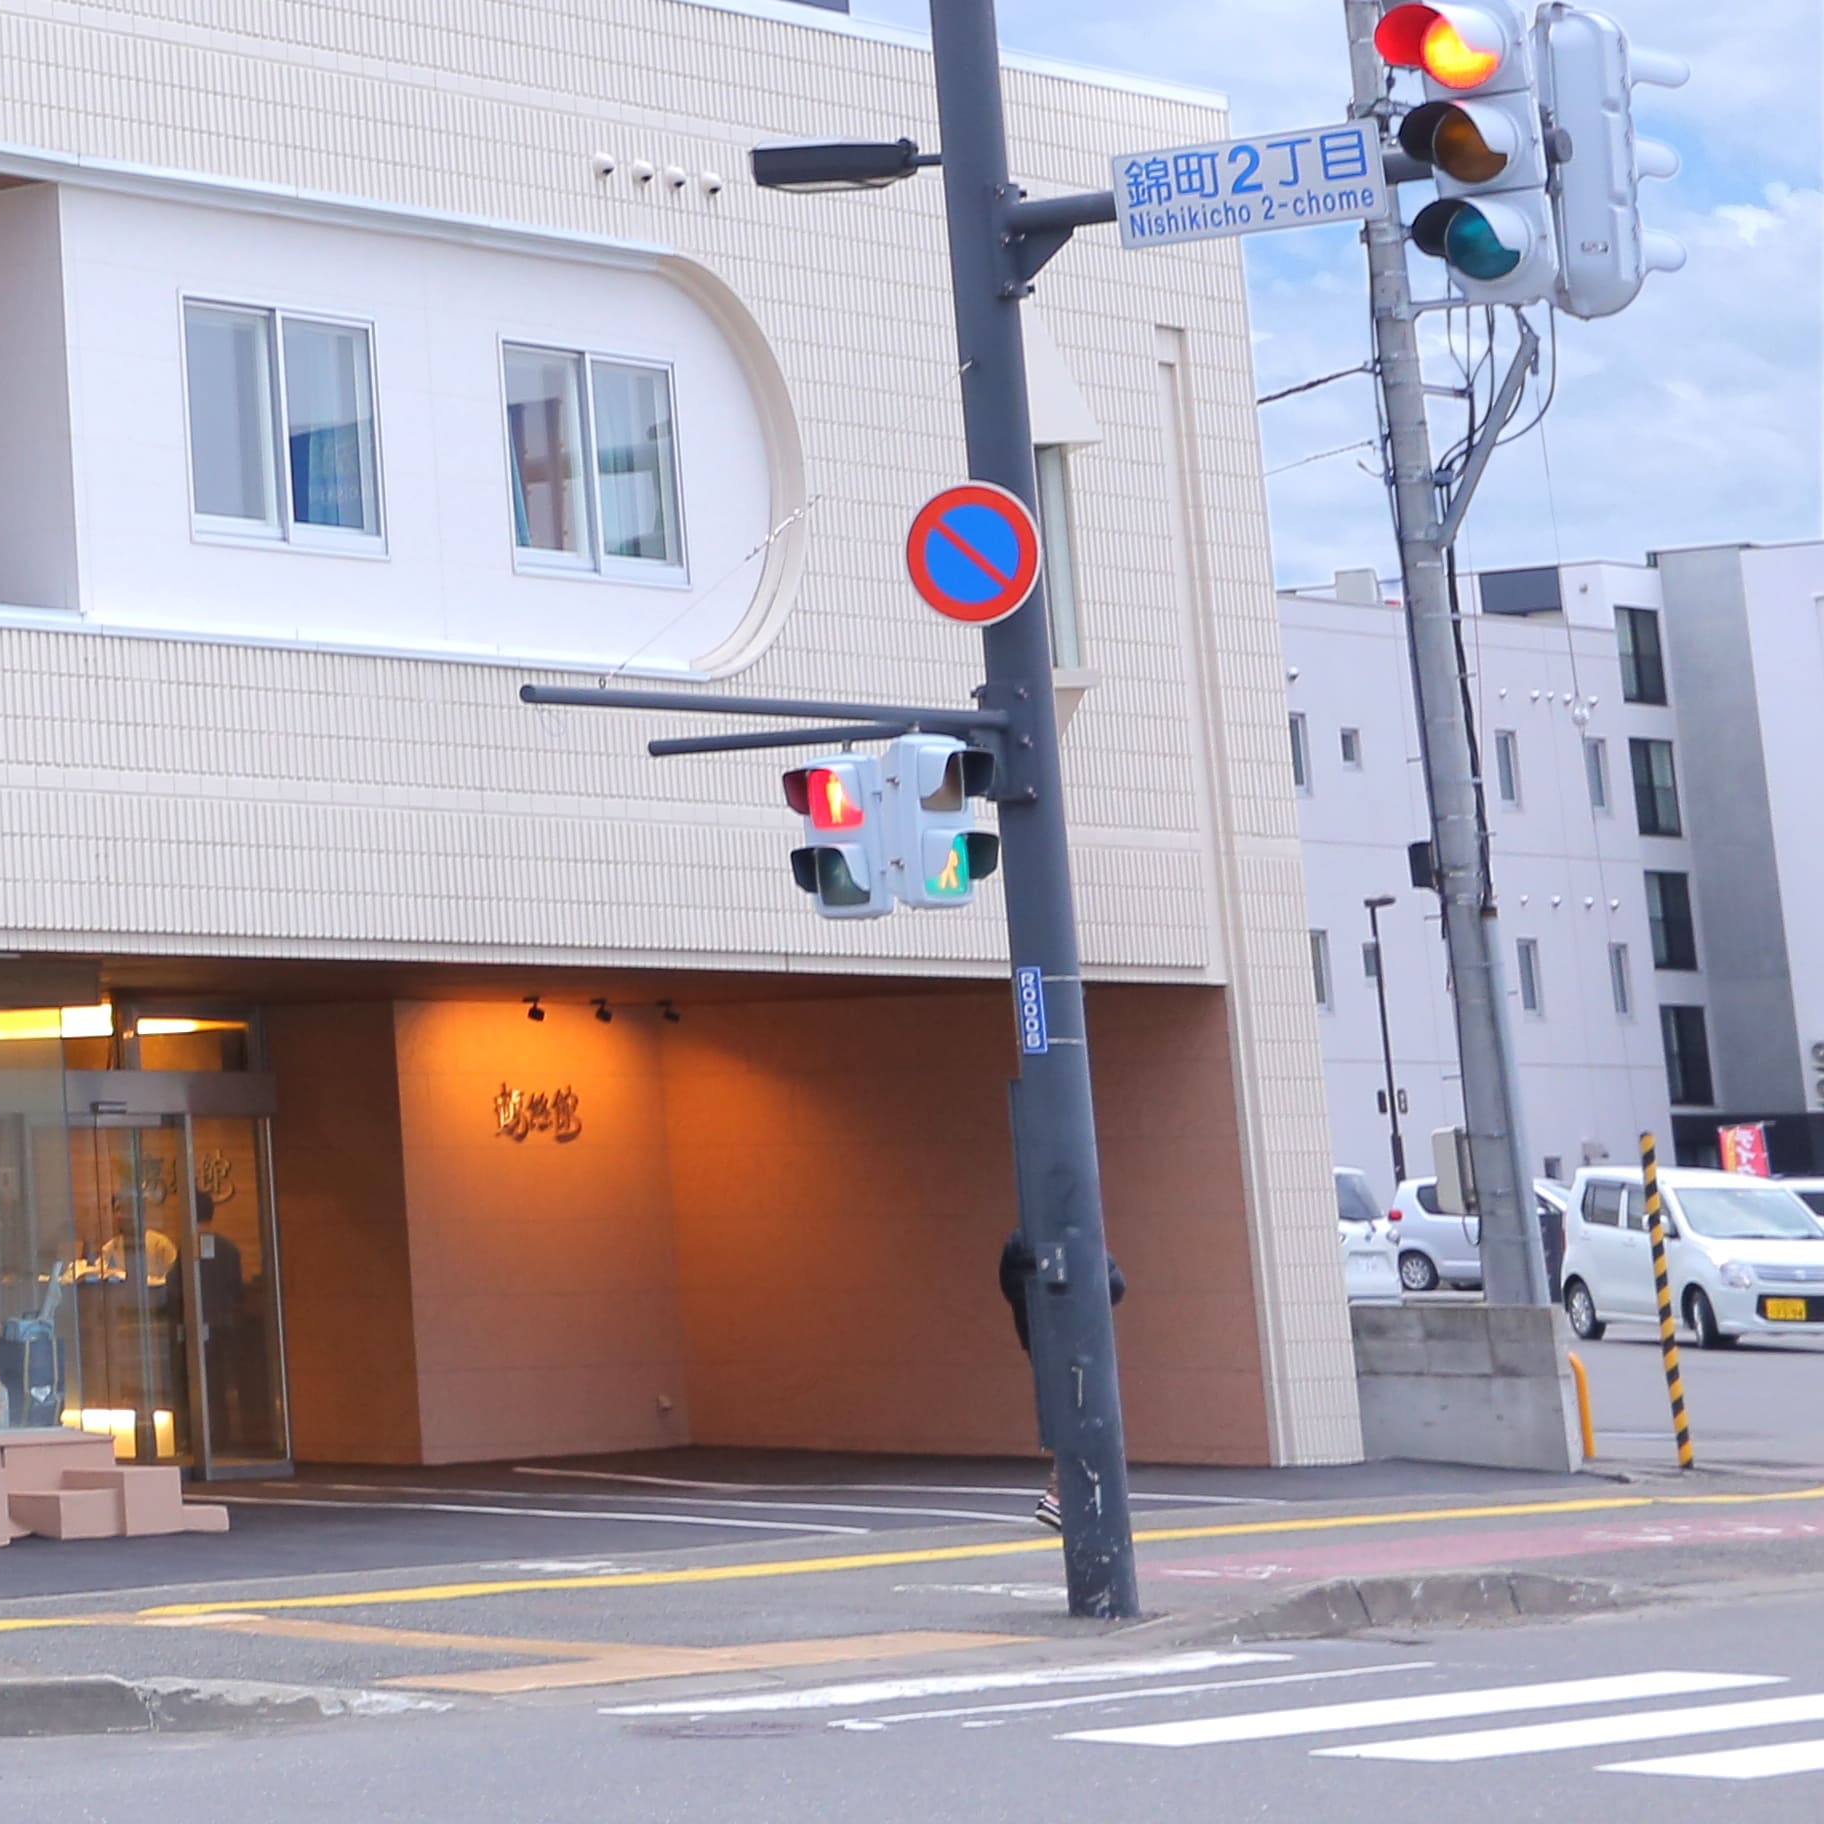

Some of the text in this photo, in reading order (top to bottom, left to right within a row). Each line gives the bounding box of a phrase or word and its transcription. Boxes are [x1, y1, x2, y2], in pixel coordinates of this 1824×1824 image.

[1124, 129, 1368, 209] 錦町2丁目
[1129, 187, 1375, 239] Nishikicho 2-chome
